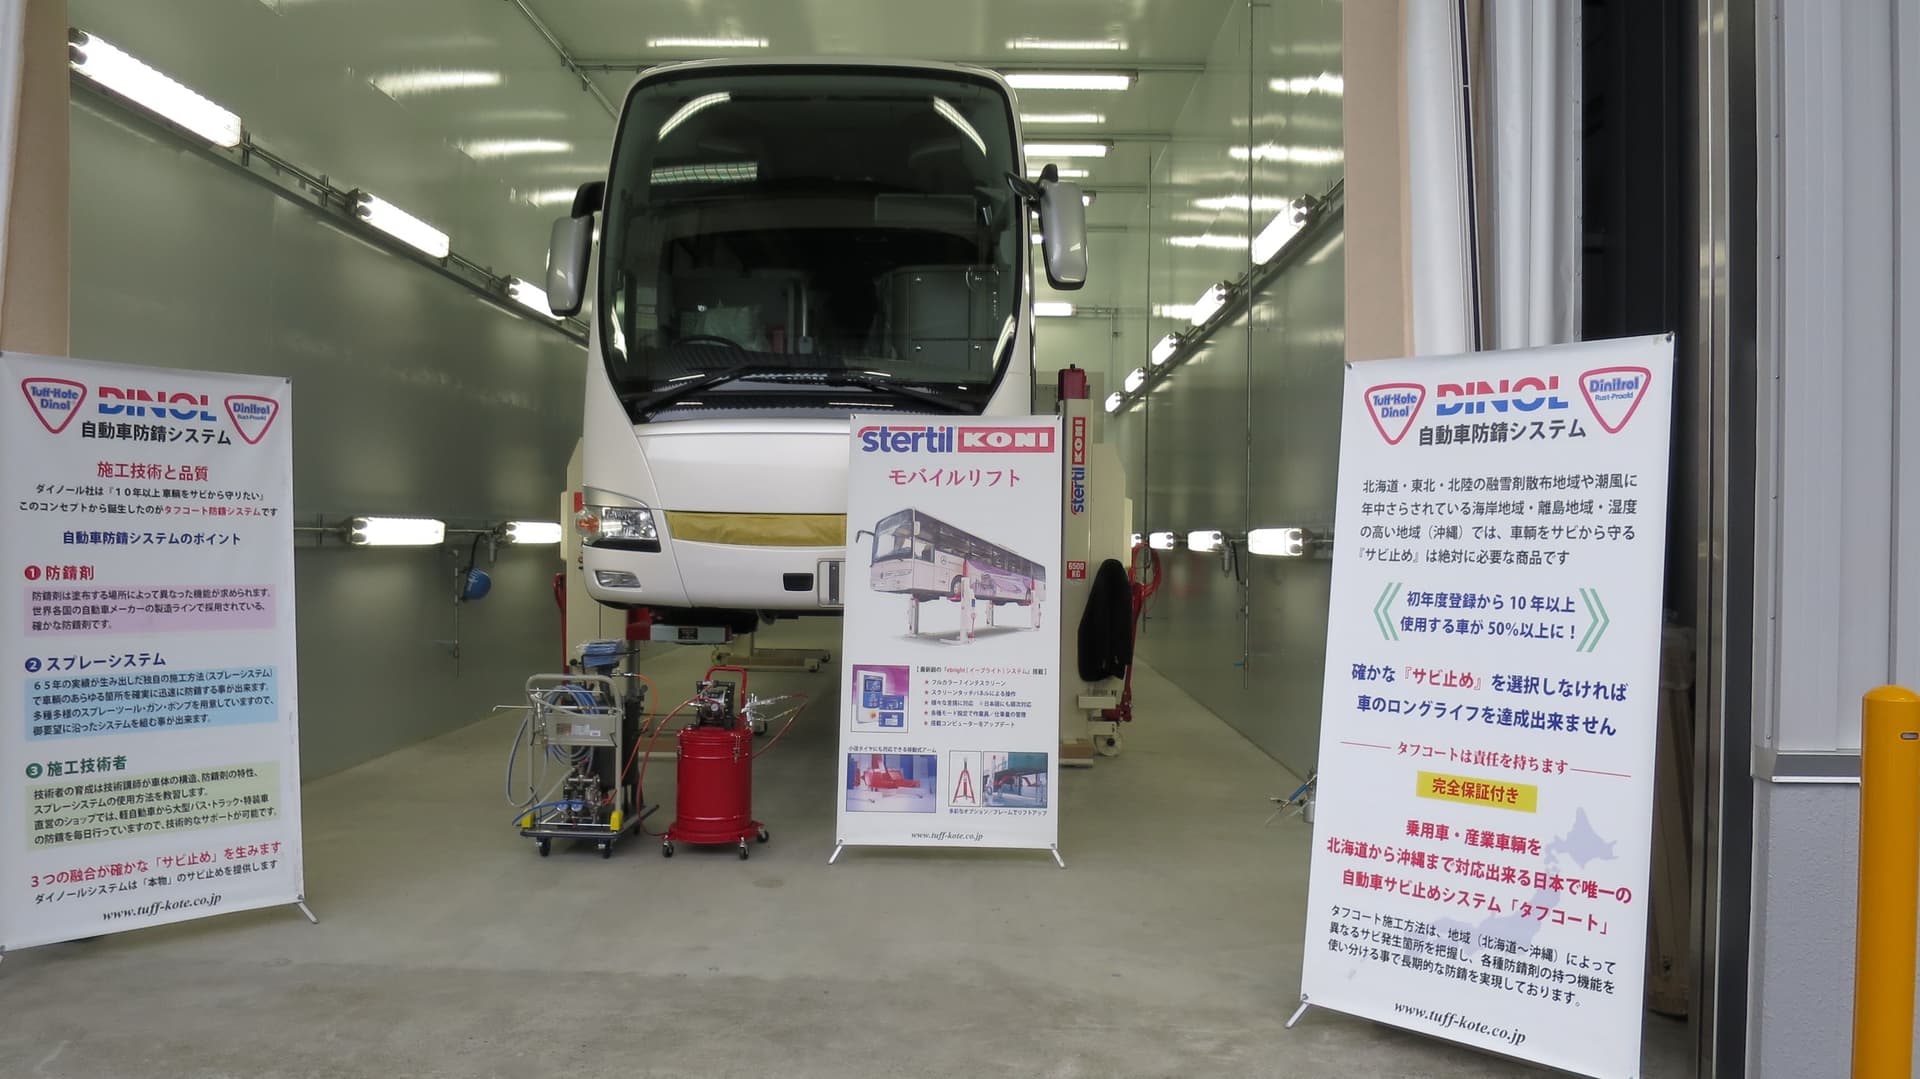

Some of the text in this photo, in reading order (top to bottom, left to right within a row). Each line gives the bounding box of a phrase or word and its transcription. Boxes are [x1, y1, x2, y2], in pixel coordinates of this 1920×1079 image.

[1436, 376, 1569, 416] DINOL
[1590, 376, 1640, 392] Dinitrol
[40, 398, 71, 411] Dinol
[99, 386, 217, 422] DINOL
[233, 402, 271, 414] Dinitrol
[1381, 406, 1409, 418] Dinol
[81, 421, 232, 446] 自動車防錆システム
[858, 426, 1049, 453] stertil KONI
[1418, 418, 1586, 446] 自動車防錆システム
[97, 461, 209, 482] 施工技術と品質
[888, 468, 1021, 487] モバイルリフト
[1071, 419, 1085, 515] stertil KONI
[1362, 473, 1638, 493] 北海道・東北・北陸の融雪剤散布地域や潮風に
[1361, 499, 1638, 516] 年中さらされている海岸地域・離島地域・湿度
[63, 531, 241, 546] 自動車防錆システムのポイント
[45, 566, 95, 580] 防錆剤
[47, 652, 167, 672] スプレーシステム
[1356, 694, 1617, 737] 車のロングライフを達成出来ません
[47, 755, 127, 777] 施工技術者
[1397, 741, 1569, 776] タフコートは責任を持ちます
[1431, 777, 1519, 804] 完全保証付き
[911, 832, 984, 840] www.tuff-kote.co.jp
[1326, 836, 1632, 904] 北海道から沖縄まで対応出来る日本で唯一の
[103, 893, 222, 921] www.tuff-kote.co.jp
[1342, 868, 1608, 935] 自動車サビ止めシステム「タフコート」
[1329, 921, 1615, 994] 異なるサビ発生箇所を把握し、各種防錆剤の持つ機能を
[1328, 938, 1581, 1007] 使い分ける事で長期的な防錆を実現しております。
[1393, 1000, 1526, 1045] www.tuff-kote.co.jp
